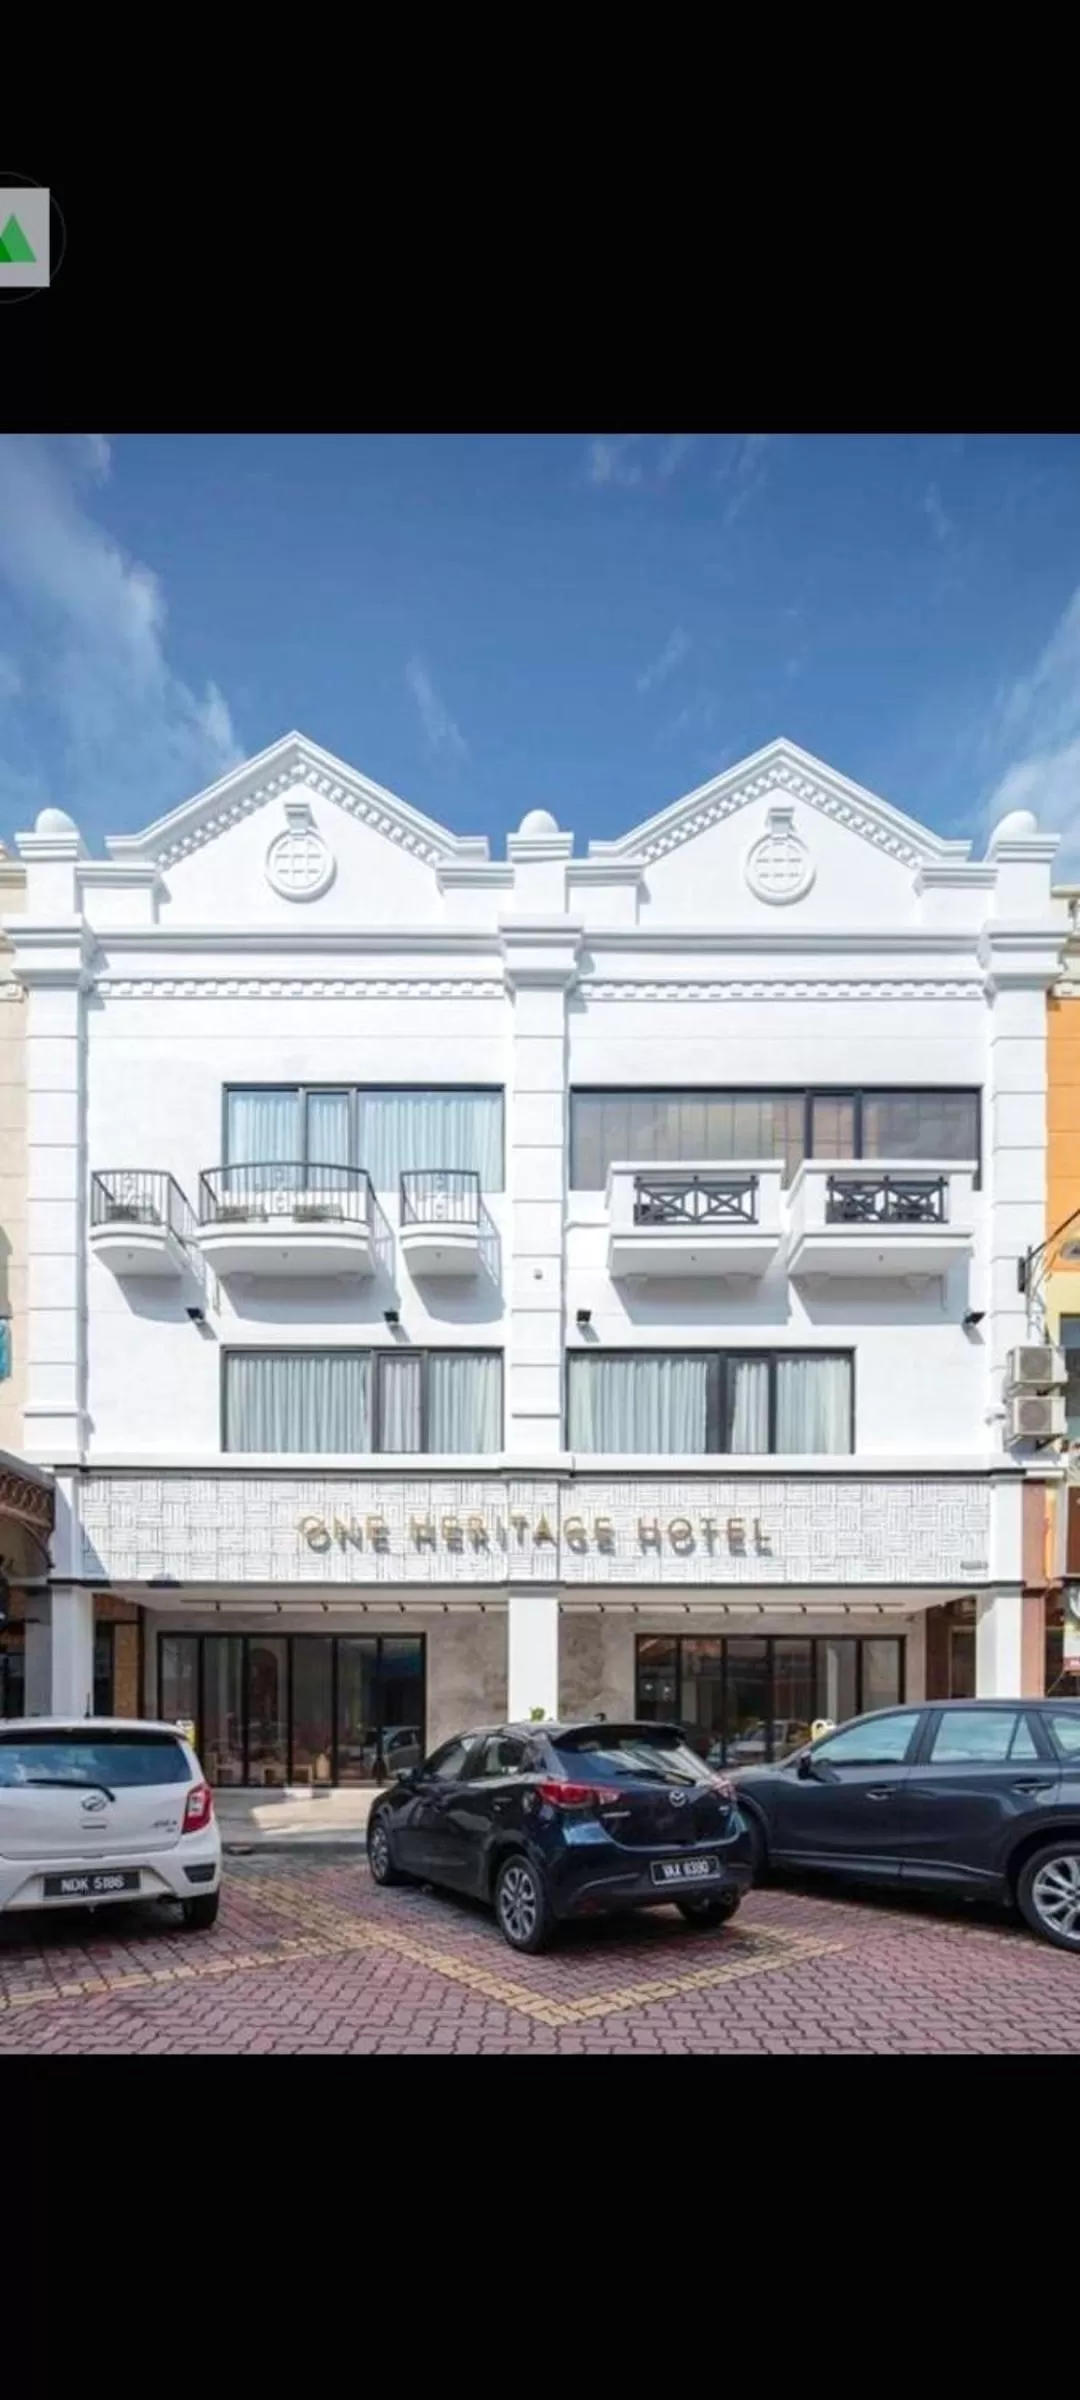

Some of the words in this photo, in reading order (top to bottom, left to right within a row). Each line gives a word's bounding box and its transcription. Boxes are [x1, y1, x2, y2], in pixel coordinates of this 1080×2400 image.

[297, 1514, 388, 1551] ONE
[408, 1514, 615, 1552] HERITAGE
[637, 1516, 772, 1553] HOTEL
